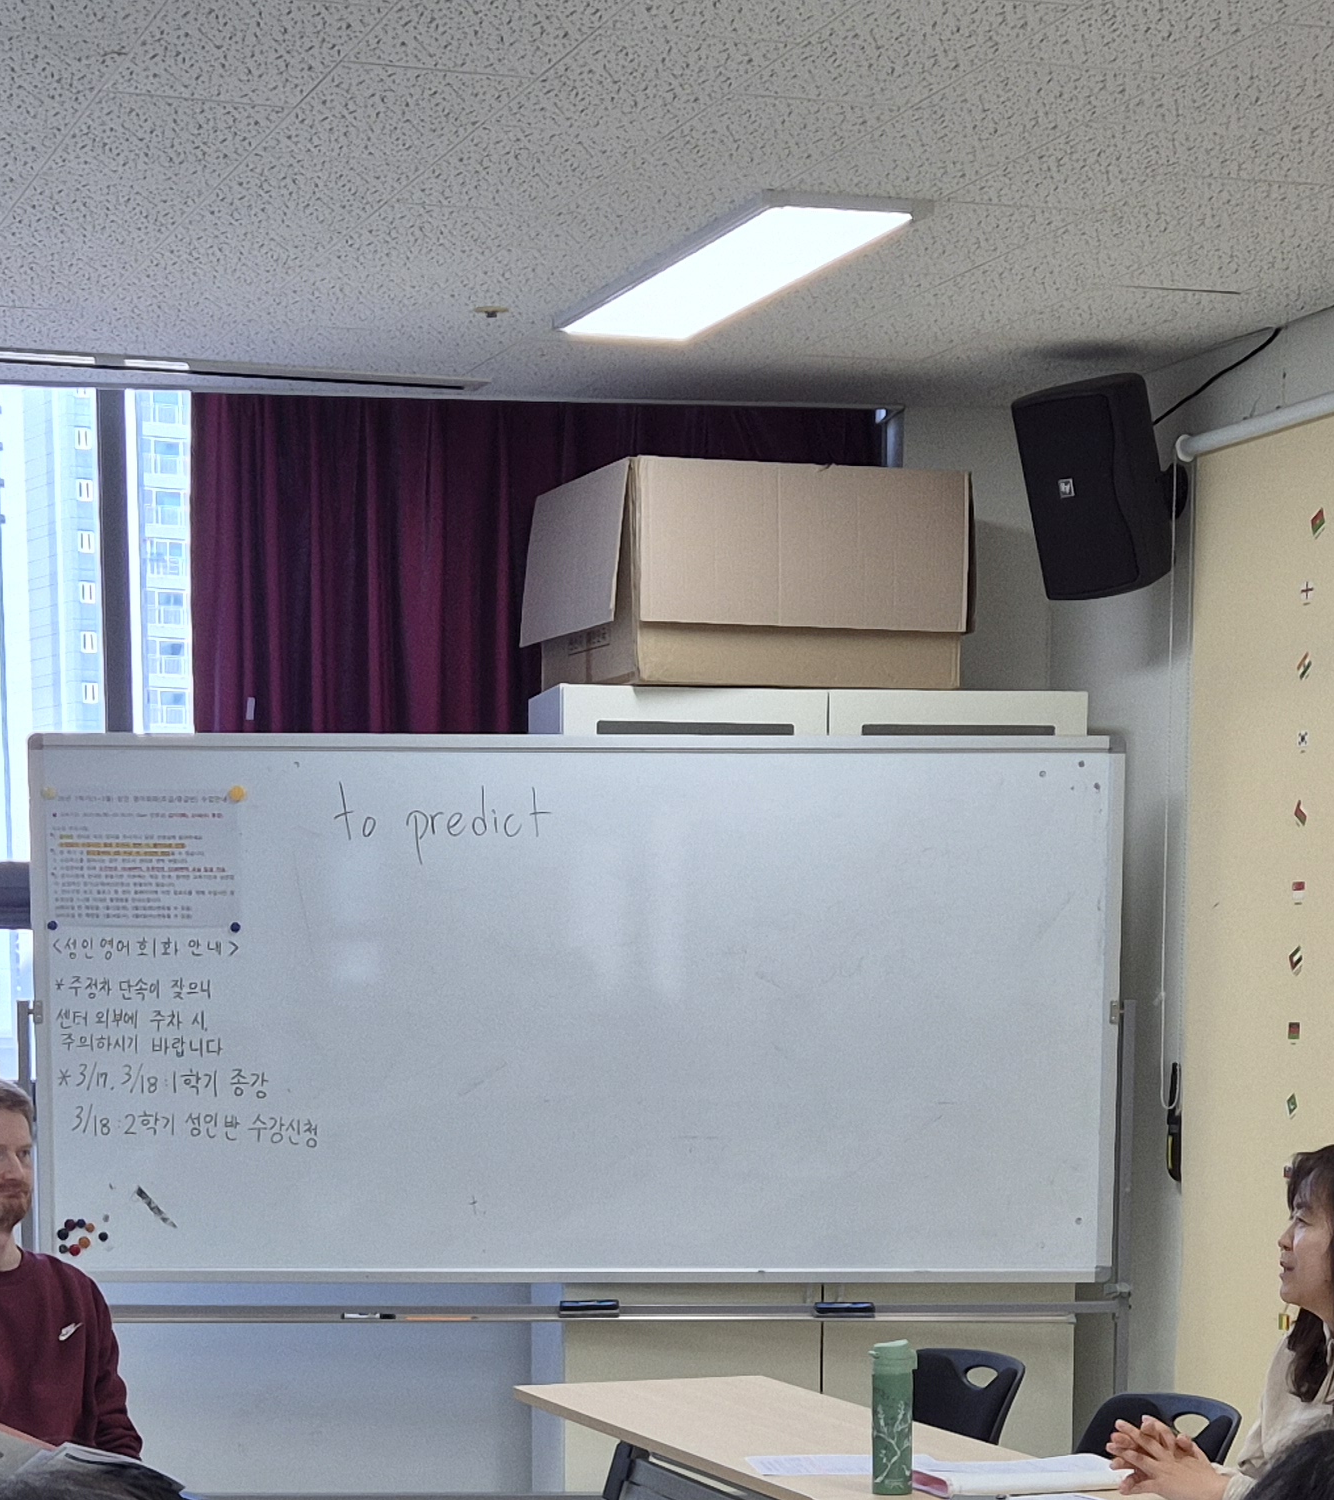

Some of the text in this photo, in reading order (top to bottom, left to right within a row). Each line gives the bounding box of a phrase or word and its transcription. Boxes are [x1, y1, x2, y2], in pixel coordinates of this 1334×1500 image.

[333, 781, 552, 865] to predict
[119, 978, 160, 1001] 단속이
[55, 1009, 88, 1029] 센터
[95, 1009, 138, 1029] 외부에
[150, 1010, 183, 1031] 주차
[61, 1033, 223, 1057] 주의하시기 바랍니다
[230, 1068, 269, 1099] 종강
[247, 1113, 318, 1148] 수강신청
